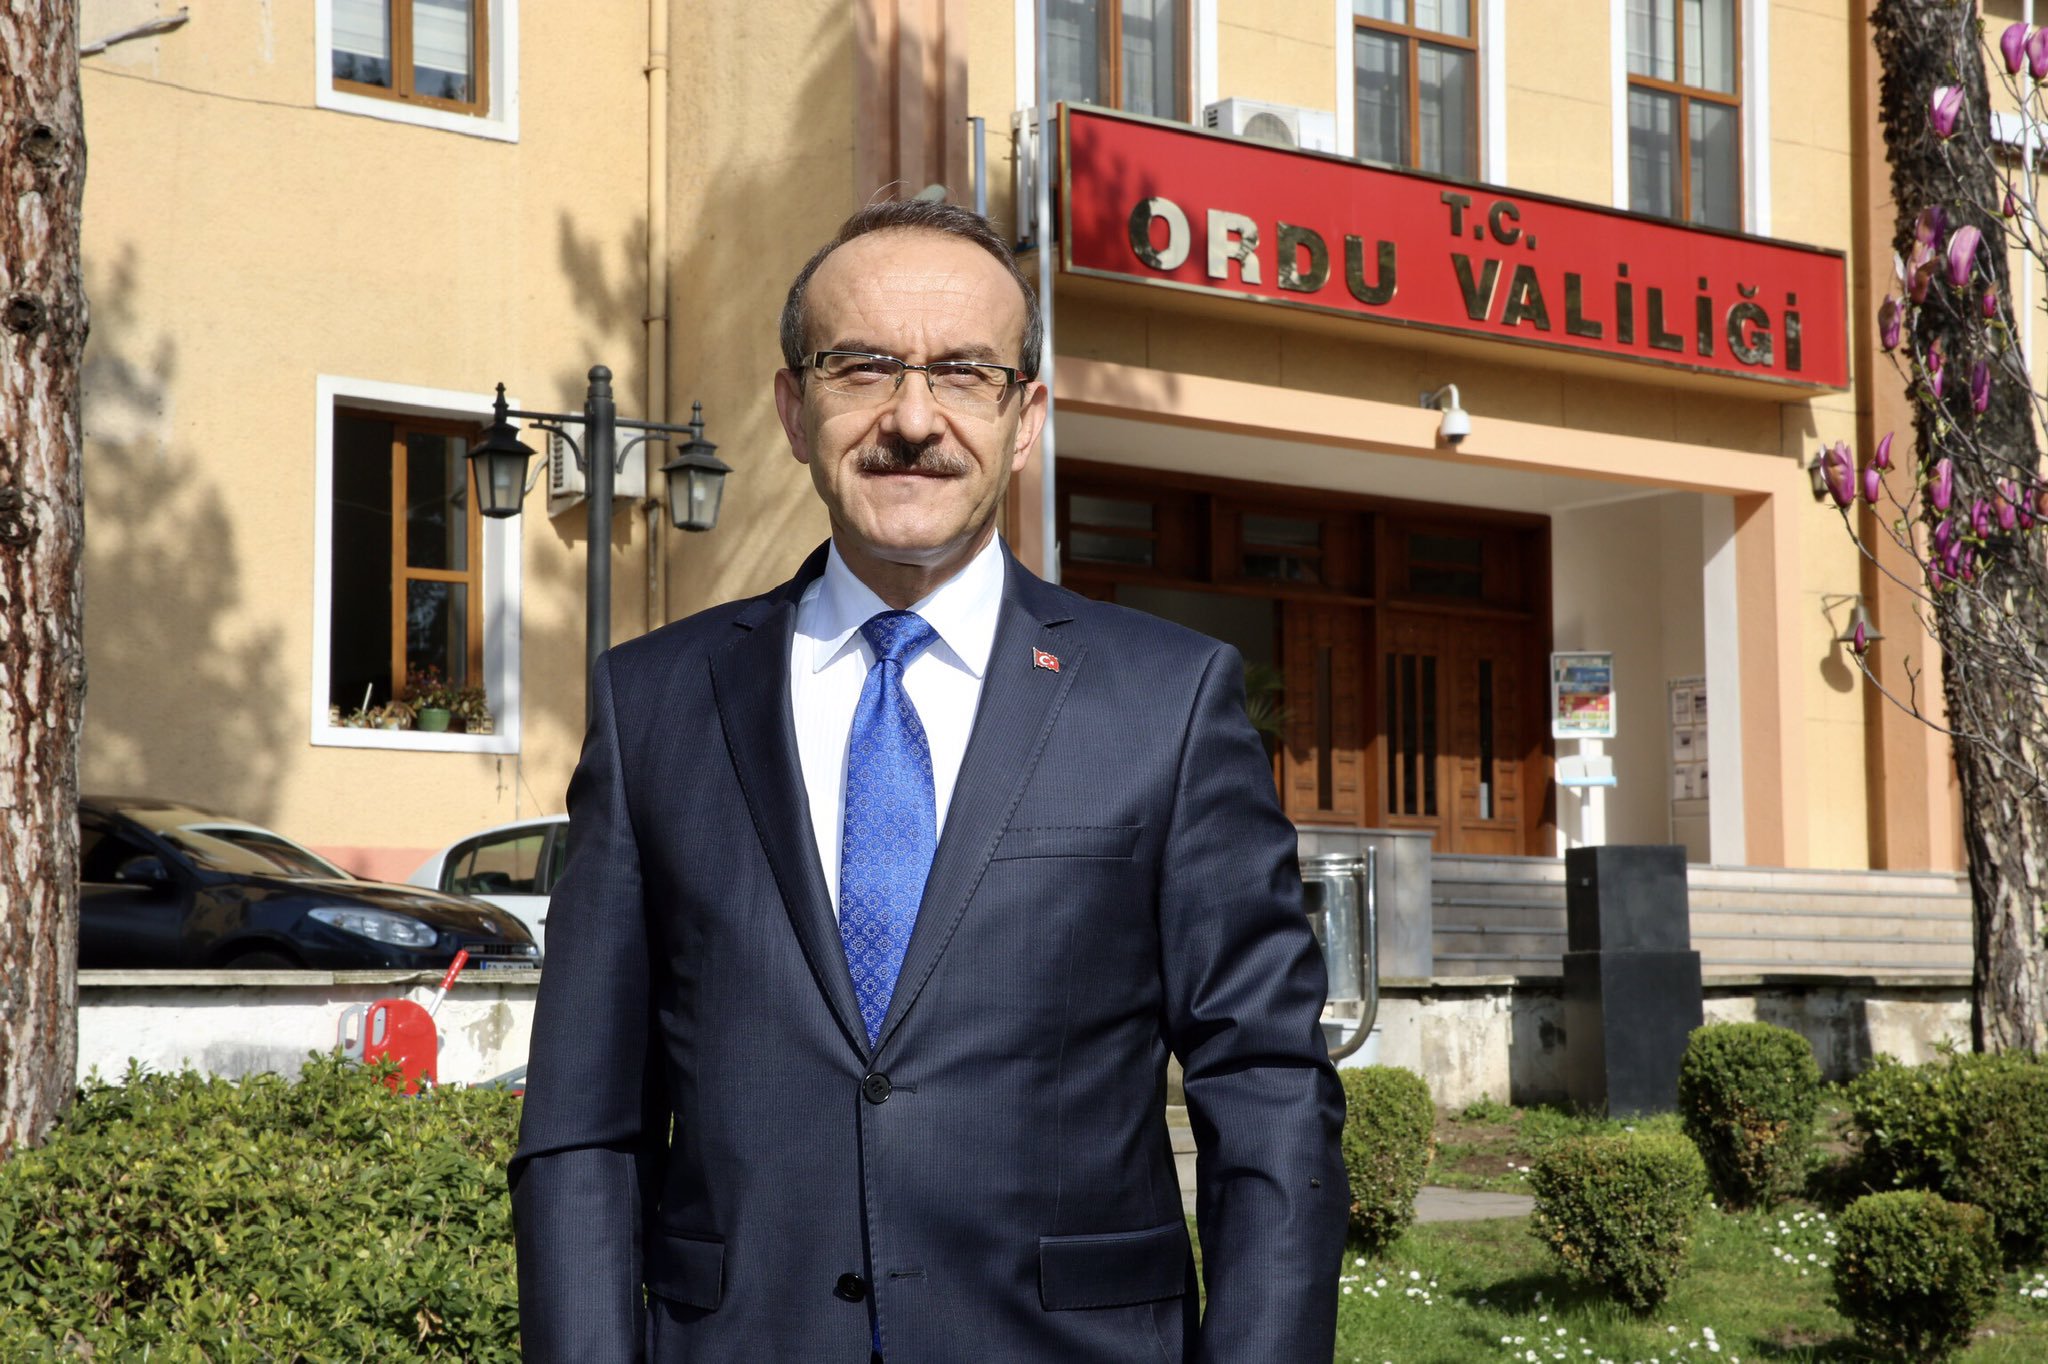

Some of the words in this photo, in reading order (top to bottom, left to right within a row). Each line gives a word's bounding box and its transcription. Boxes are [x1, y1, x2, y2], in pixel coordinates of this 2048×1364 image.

[1440, 190, 1537, 250] T.C.
[1127, 196, 1397, 305] ORDU
[1451, 252, 1802, 371] VALİLİĞİ
